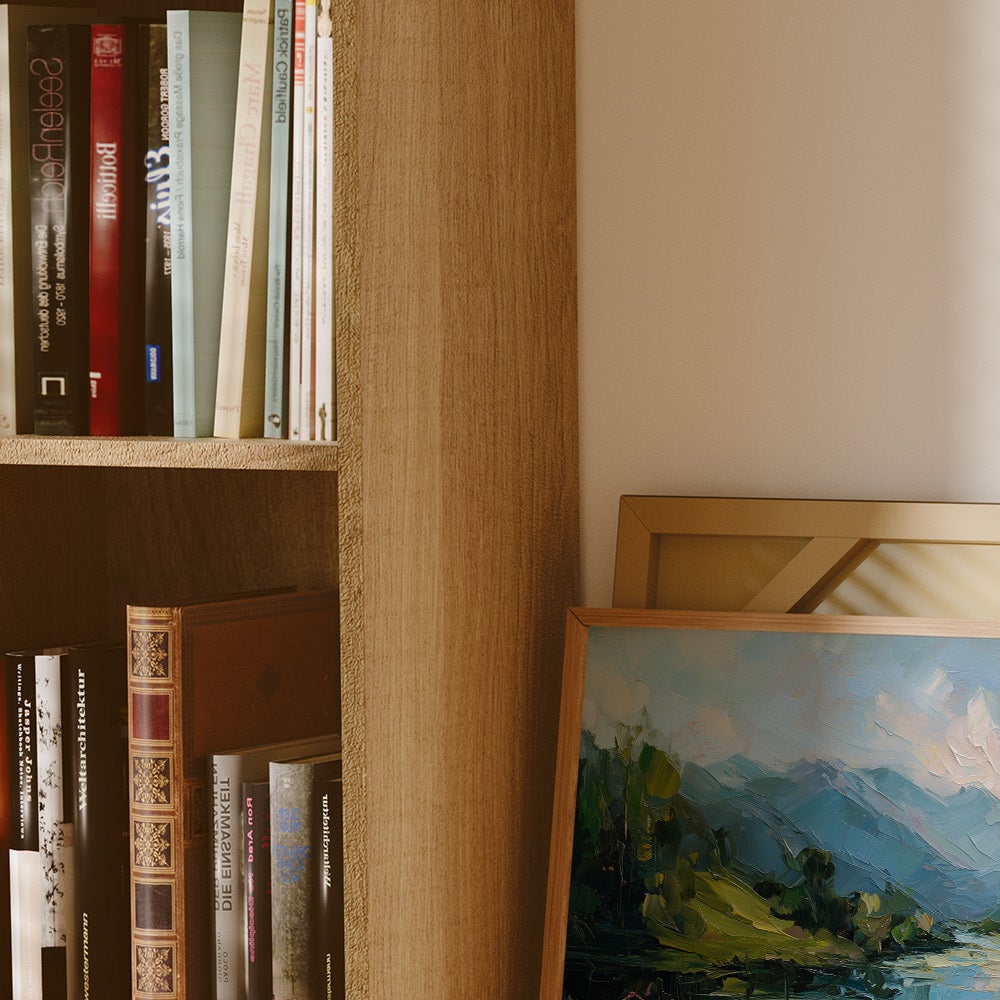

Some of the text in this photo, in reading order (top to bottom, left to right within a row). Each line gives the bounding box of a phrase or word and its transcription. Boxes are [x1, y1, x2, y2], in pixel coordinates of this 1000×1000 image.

[23, 699, 33, 803] Jasper Johns
[77, 668, 88, 807] Weltarchitektur
